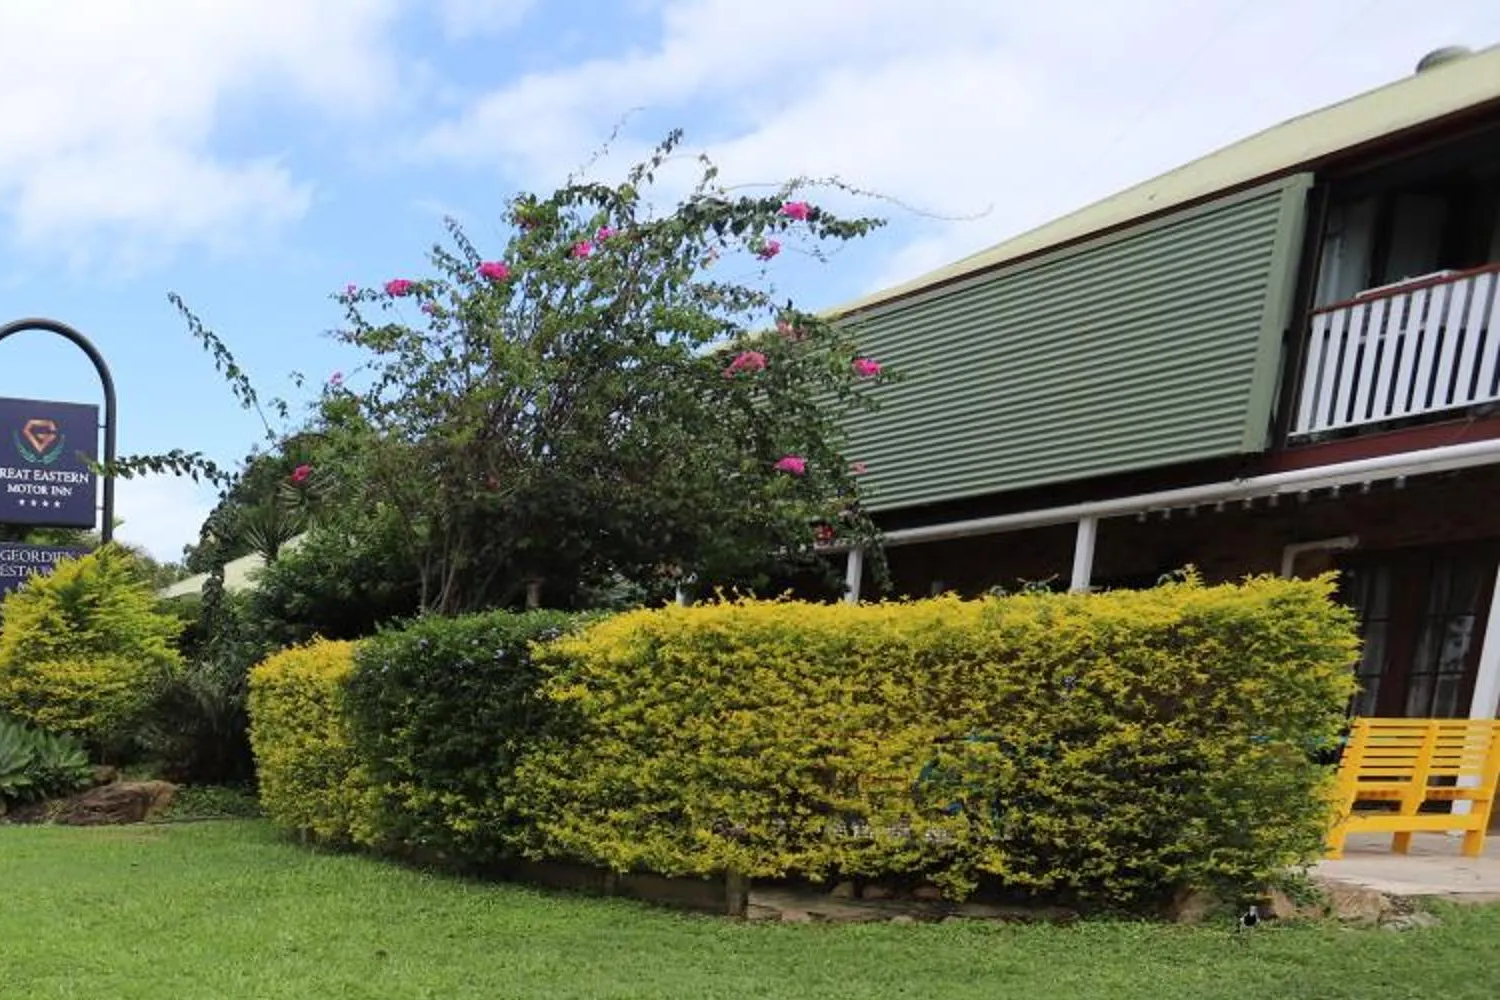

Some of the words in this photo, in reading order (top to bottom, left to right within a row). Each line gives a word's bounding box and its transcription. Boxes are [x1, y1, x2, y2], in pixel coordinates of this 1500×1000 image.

[33, 469, 89, 483] EASTERN
[7, 483, 48, 495] MOTOR
[51, 485, 73, 497] INN
